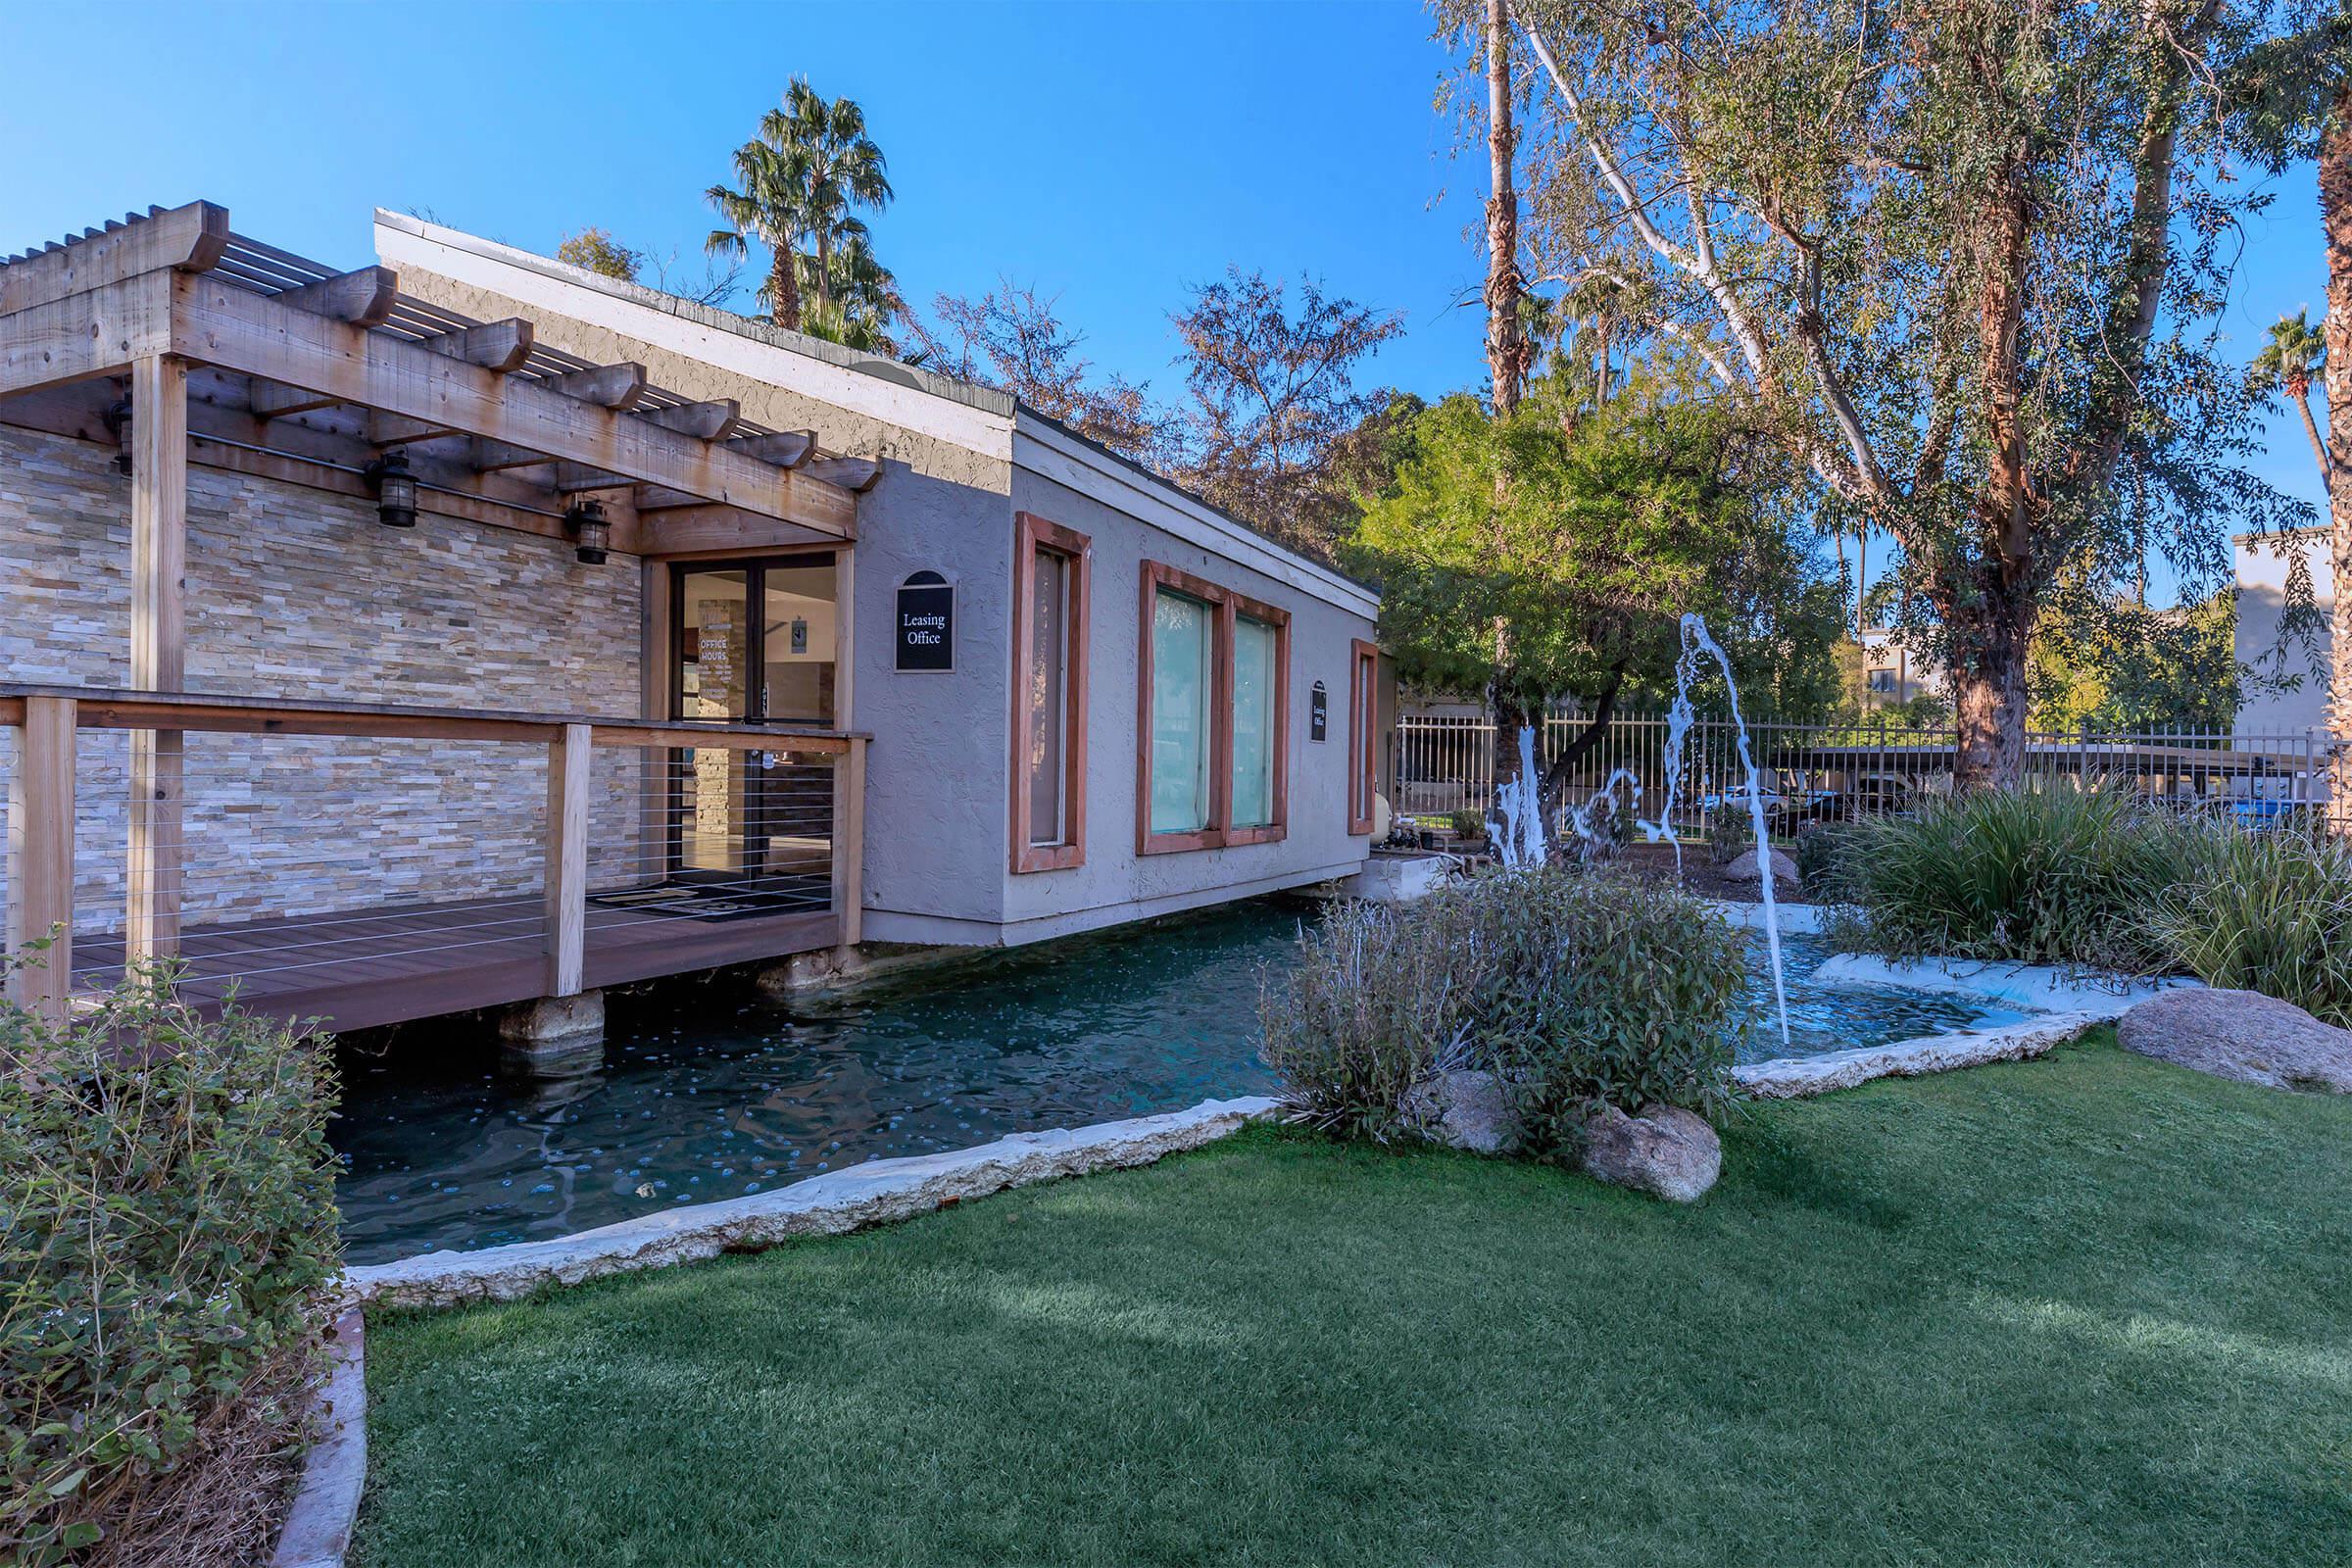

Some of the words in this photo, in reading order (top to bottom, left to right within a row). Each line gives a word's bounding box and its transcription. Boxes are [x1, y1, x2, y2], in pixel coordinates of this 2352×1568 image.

[904, 612, 946, 629] Leasing
[907, 630, 941, 645] Office
[700, 639, 727, 649] OFFICE
[702, 651, 727, 661] HOURS
